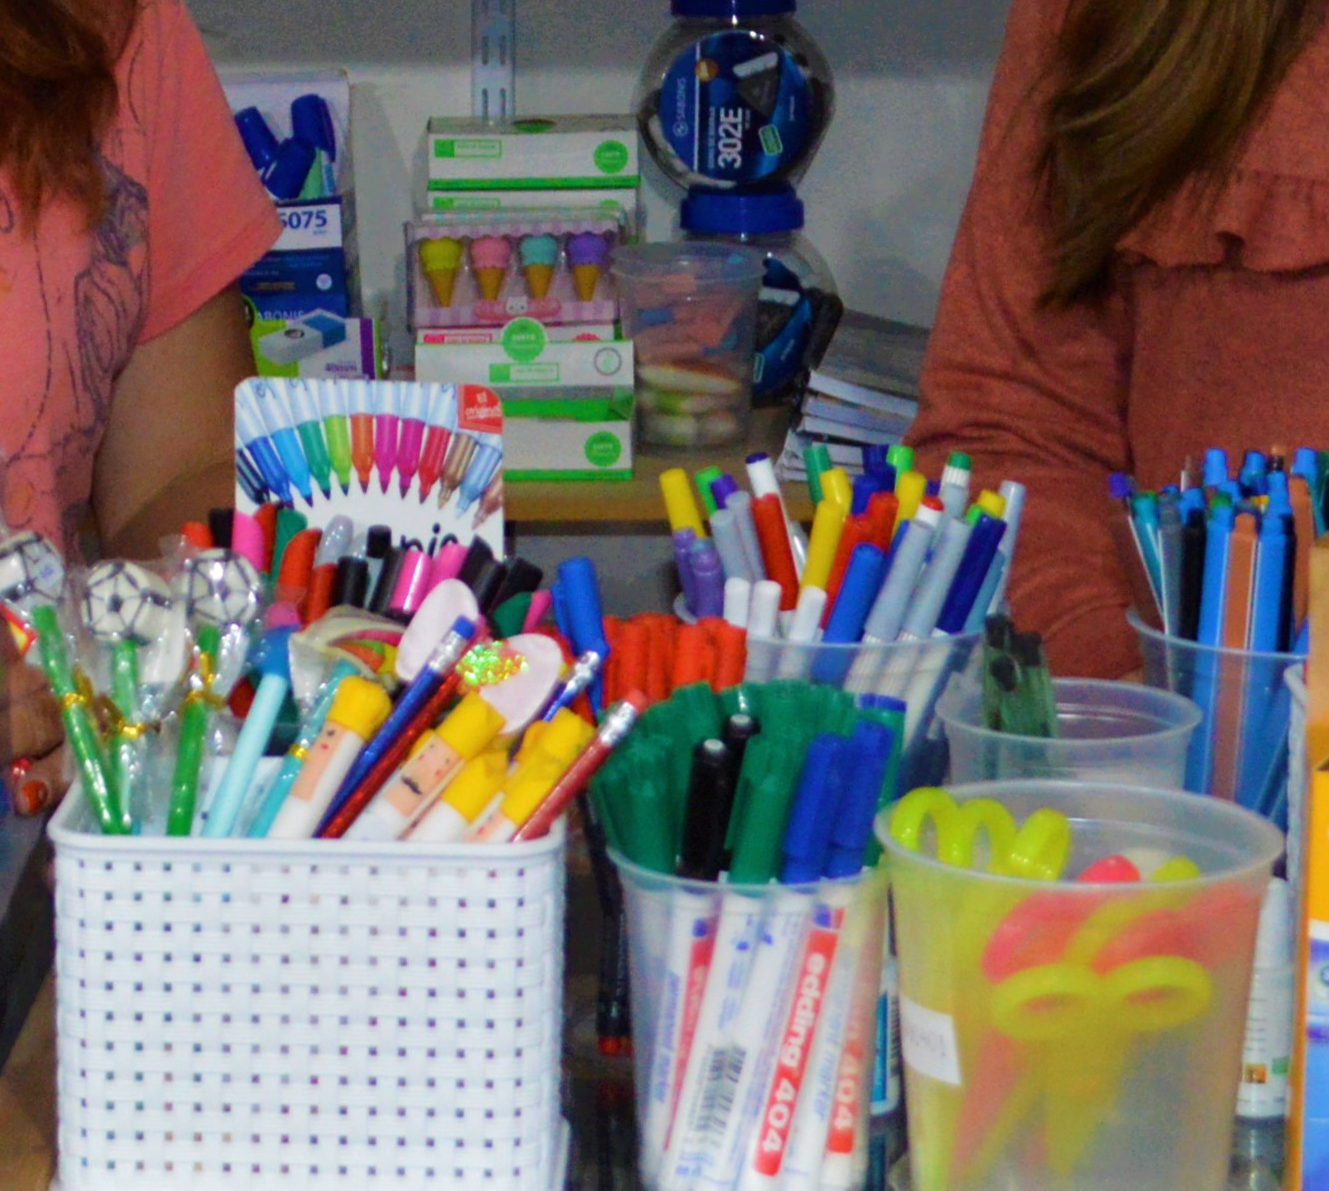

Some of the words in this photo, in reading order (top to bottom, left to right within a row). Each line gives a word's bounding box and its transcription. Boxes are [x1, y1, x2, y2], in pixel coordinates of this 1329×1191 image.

[718, 108, 742, 168] 302E
[781, 952, 826, 1068] edding
[763, 1078, 795, 1153] 404
